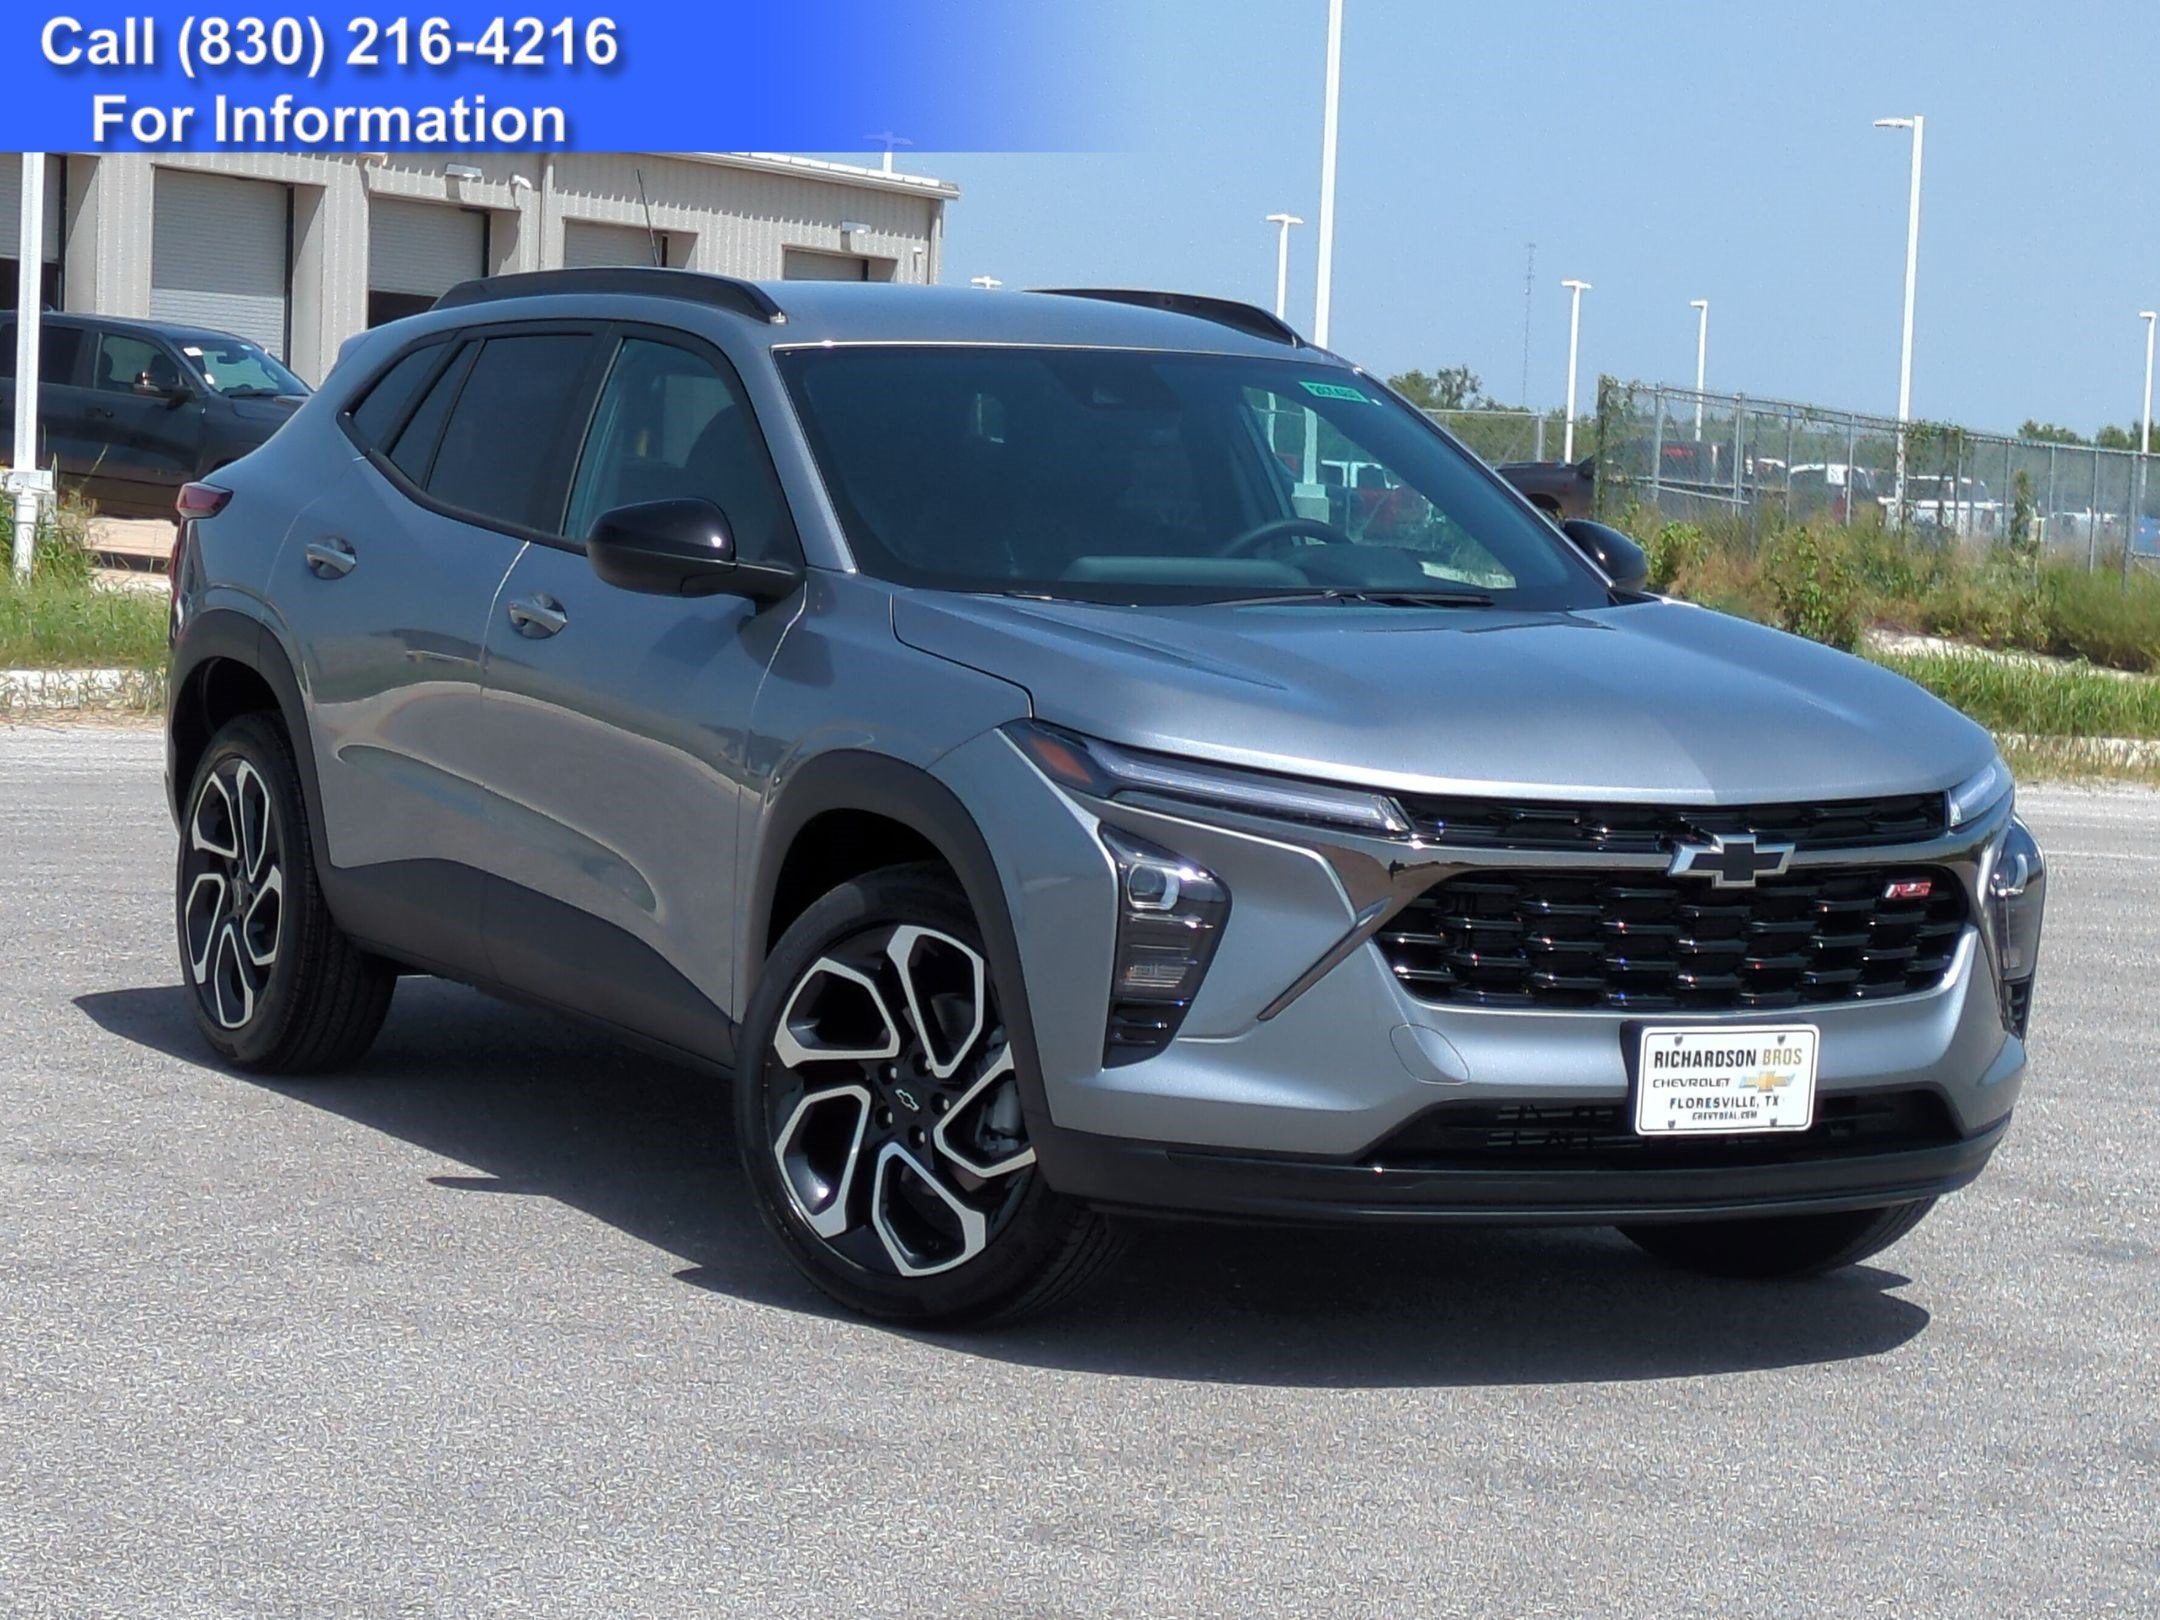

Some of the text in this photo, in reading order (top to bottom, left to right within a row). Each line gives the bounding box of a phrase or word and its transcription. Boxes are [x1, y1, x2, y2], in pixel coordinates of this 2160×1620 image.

[1885, 882, 1931, 898] RS
[1654, 1048, 1802, 1068] RICHARDSON BROS
[1652, 1077, 1730, 1088] CHEVROLET
[1669, 1095, 1779, 1109] FLORESVILLE, TX
